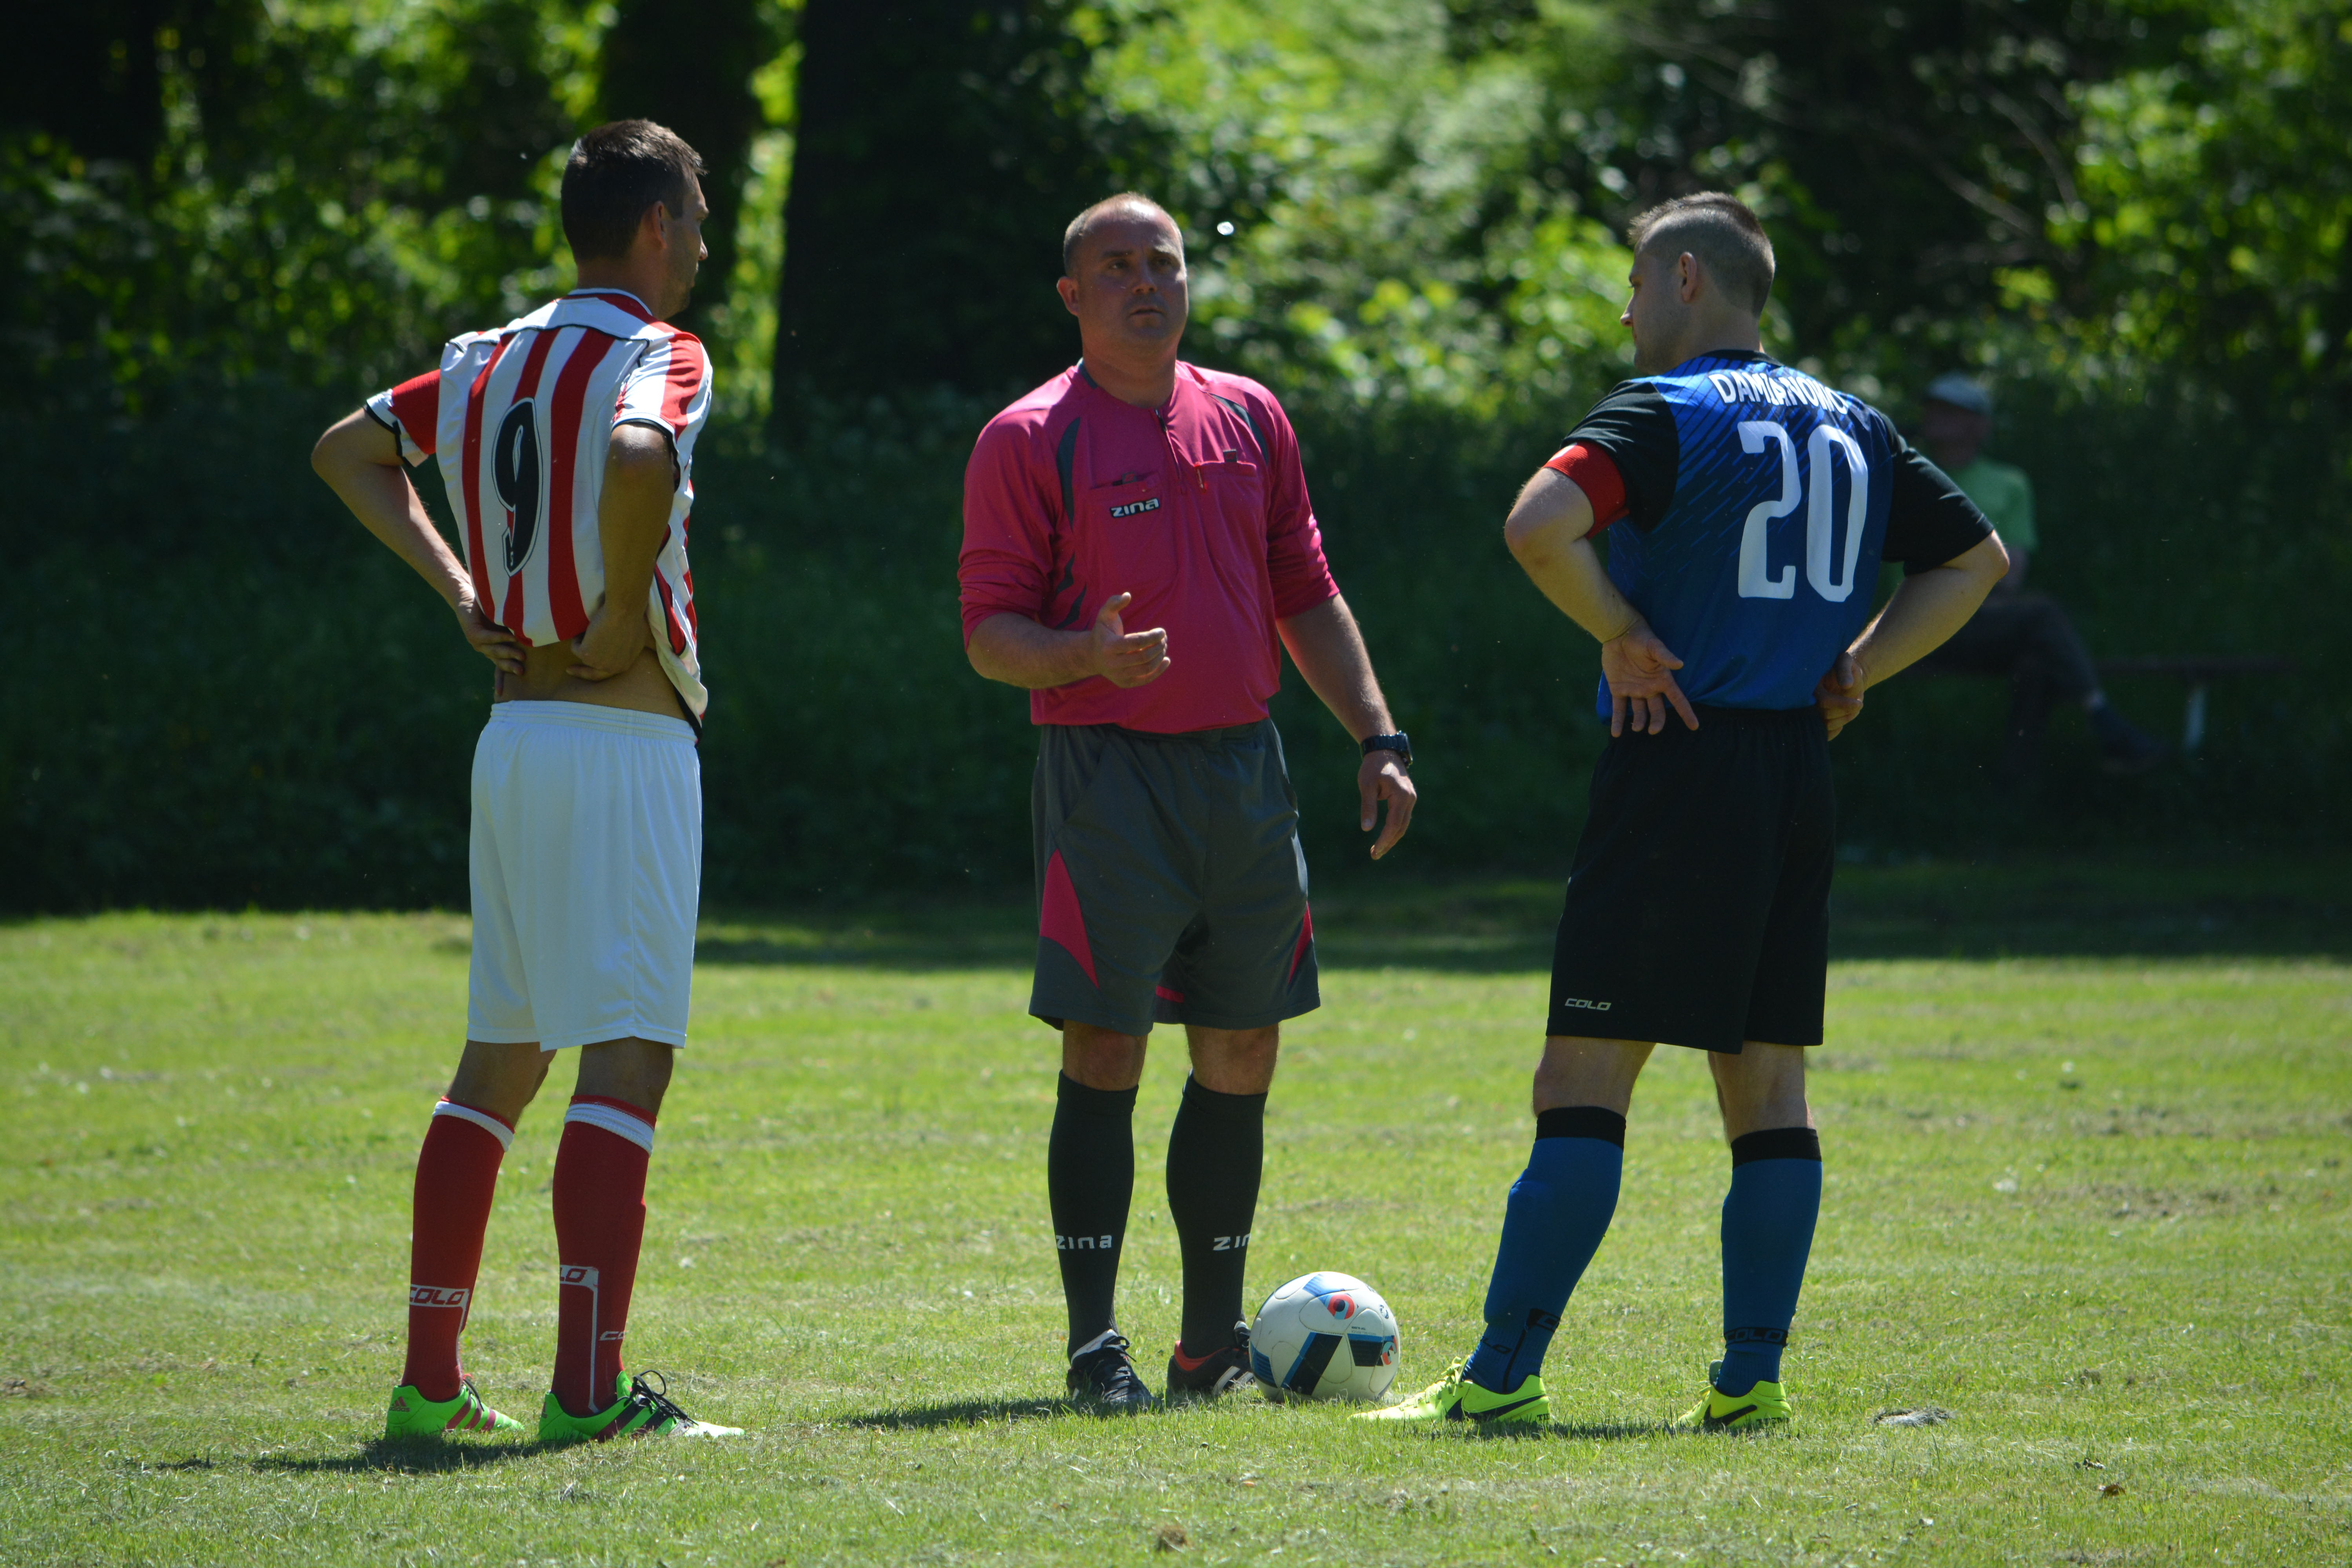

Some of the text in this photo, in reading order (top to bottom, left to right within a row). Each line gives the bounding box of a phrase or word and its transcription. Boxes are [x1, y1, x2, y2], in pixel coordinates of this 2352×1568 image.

[491, 396, 543, 577] 9
[1111, 498, 1159, 517] zina
[1737, 420, 1869, 603] 20
[1564, 998, 1612, 1011] COLO
[1056, 1234, 1112, 1250] zina
